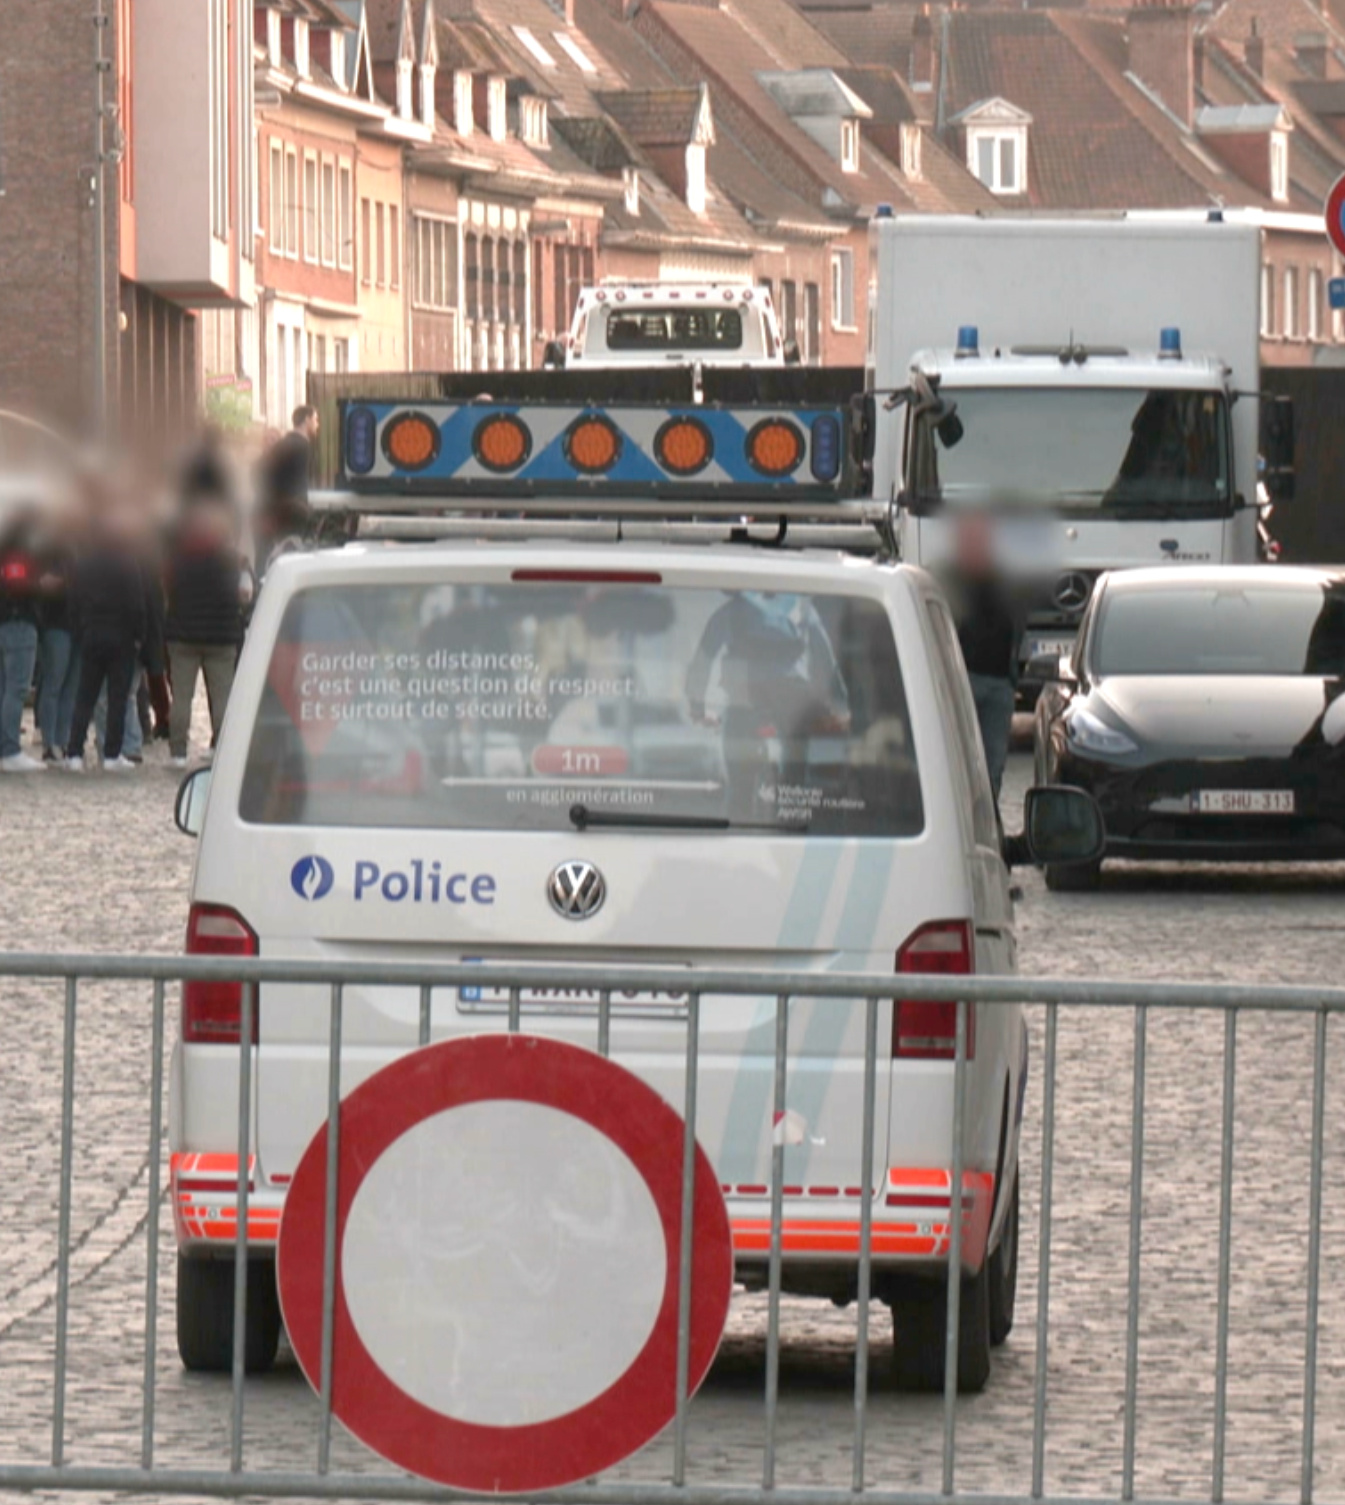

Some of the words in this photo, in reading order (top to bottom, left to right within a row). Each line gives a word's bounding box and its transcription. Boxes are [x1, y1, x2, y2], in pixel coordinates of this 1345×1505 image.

[302, 651, 375, 672] Garder
[384, 653, 421, 671] ses
[426, 650, 540, 673] distances,
[300, 676, 354, 696] c'est
[359, 677, 401, 695] une
[408, 673, 508, 698] question
[515, 674, 542, 695] de
[300, 700, 325, 721] Et
[330, 699, 415, 720] surtout
[421, 698, 449, 719] de
[456, 697, 553, 720] sécurité.
[562, 749, 600, 772] 1m
[506, 788, 526, 803] en
[531, 784, 654, 807] agglomération
[354, 859, 497, 905] Police
